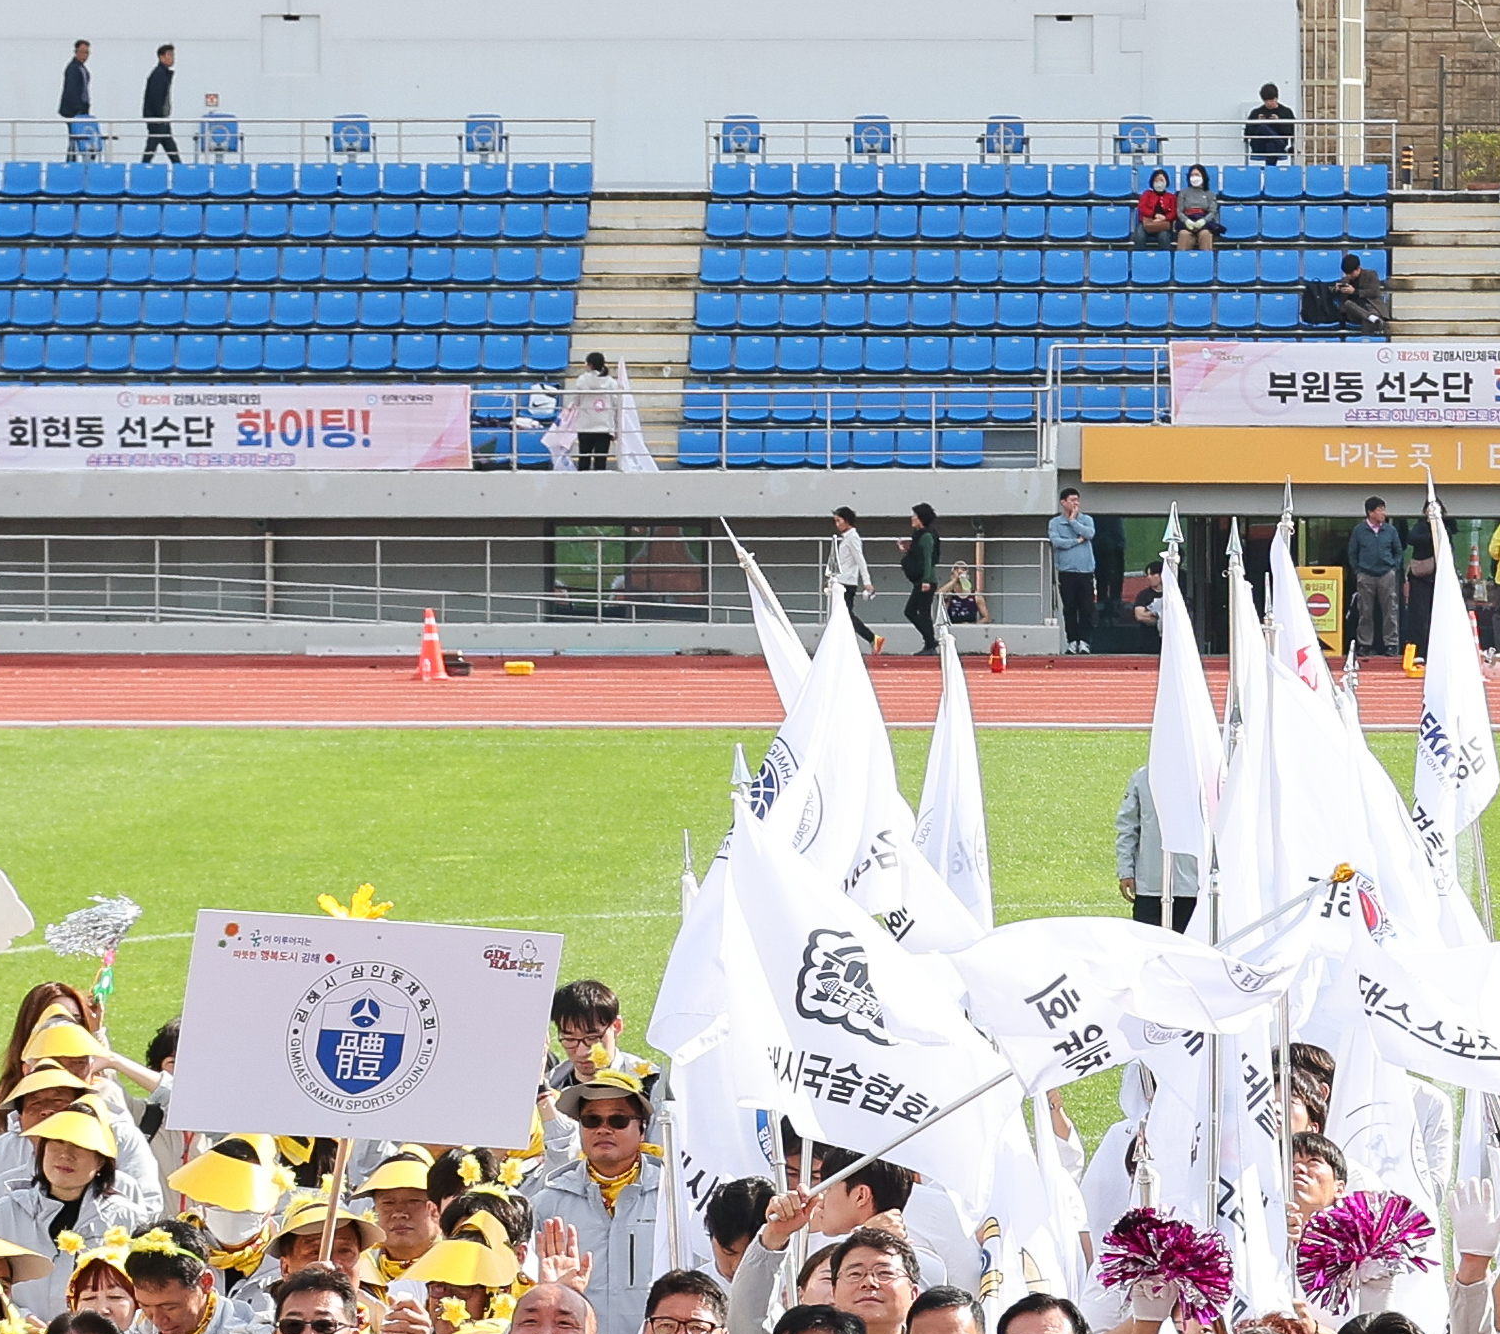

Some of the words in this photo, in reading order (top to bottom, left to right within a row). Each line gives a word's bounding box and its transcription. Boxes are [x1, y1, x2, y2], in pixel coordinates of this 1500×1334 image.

[1267, 370, 1364, 406] 부원동
[1376, 369, 1474, 405] 선수단
[8, 415, 105, 449] 회현동
[117, 414, 215, 449] 선수단
[235, 407, 372, 449] 화이팅!
[1323, 442, 1400, 468] 나가는
[1408, 441, 1433, 469] 곳
[260, 949, 299, 964] 행복도시
[301, 952, 320, 964] 김해
[290, 1037, 311, 1084] GIMHAE
[304, 1080, 345, 1110] SAMAN
[345, 1091, 395, 1110] SPORTS
[335, 1031, 386, 1082] 體
